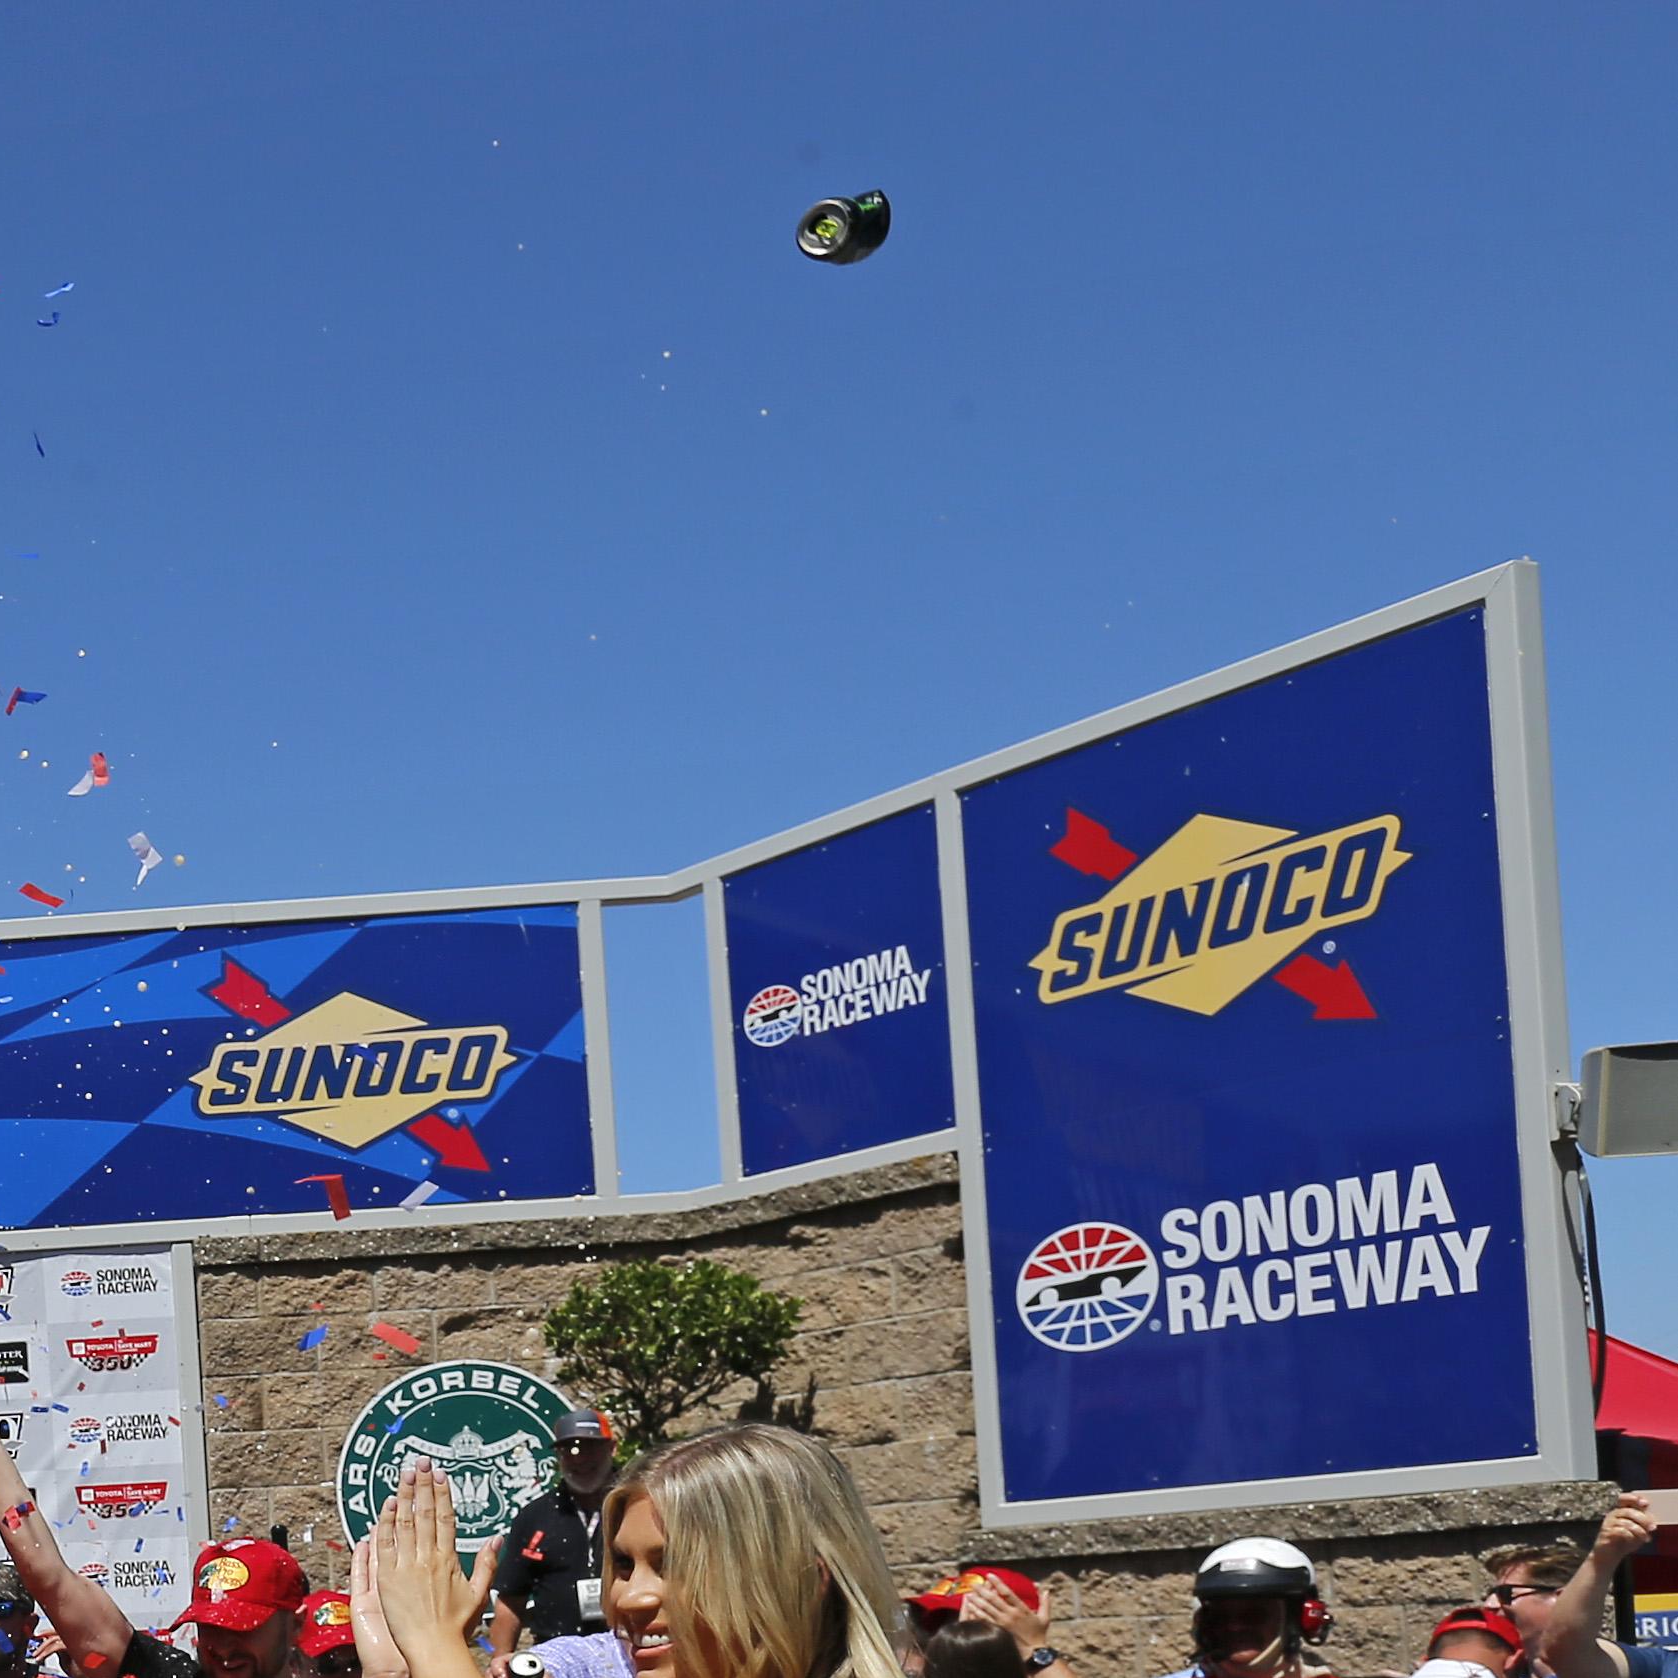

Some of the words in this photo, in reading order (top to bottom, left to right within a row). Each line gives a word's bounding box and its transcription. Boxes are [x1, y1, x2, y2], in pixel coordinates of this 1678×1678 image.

[1048, 826, 1388, 993] SUNOCO
[800, 945, 912, 1006] SONOMA
[803, 968, 931, 1037] RACEWAY
[210, 1034, 497, 1106] SUNOCO
[1161, 1162, 1455, 1270] SONOMA
[97, 1267, 153, 1282] SONOMA
[97, 1280, 159, 1296] RACEWAY
[1165, 1226, 1491, 1335] RACEWAY
[92, 1356, 134, 1372] 350
[385, 1369, 540, 1416] KORBEL
[106, 1414, 161, 1428] SONOMA
[107, 1427, 168, 1442] RACEWAY
[115, 1560, 170, 1574] SONOMA
